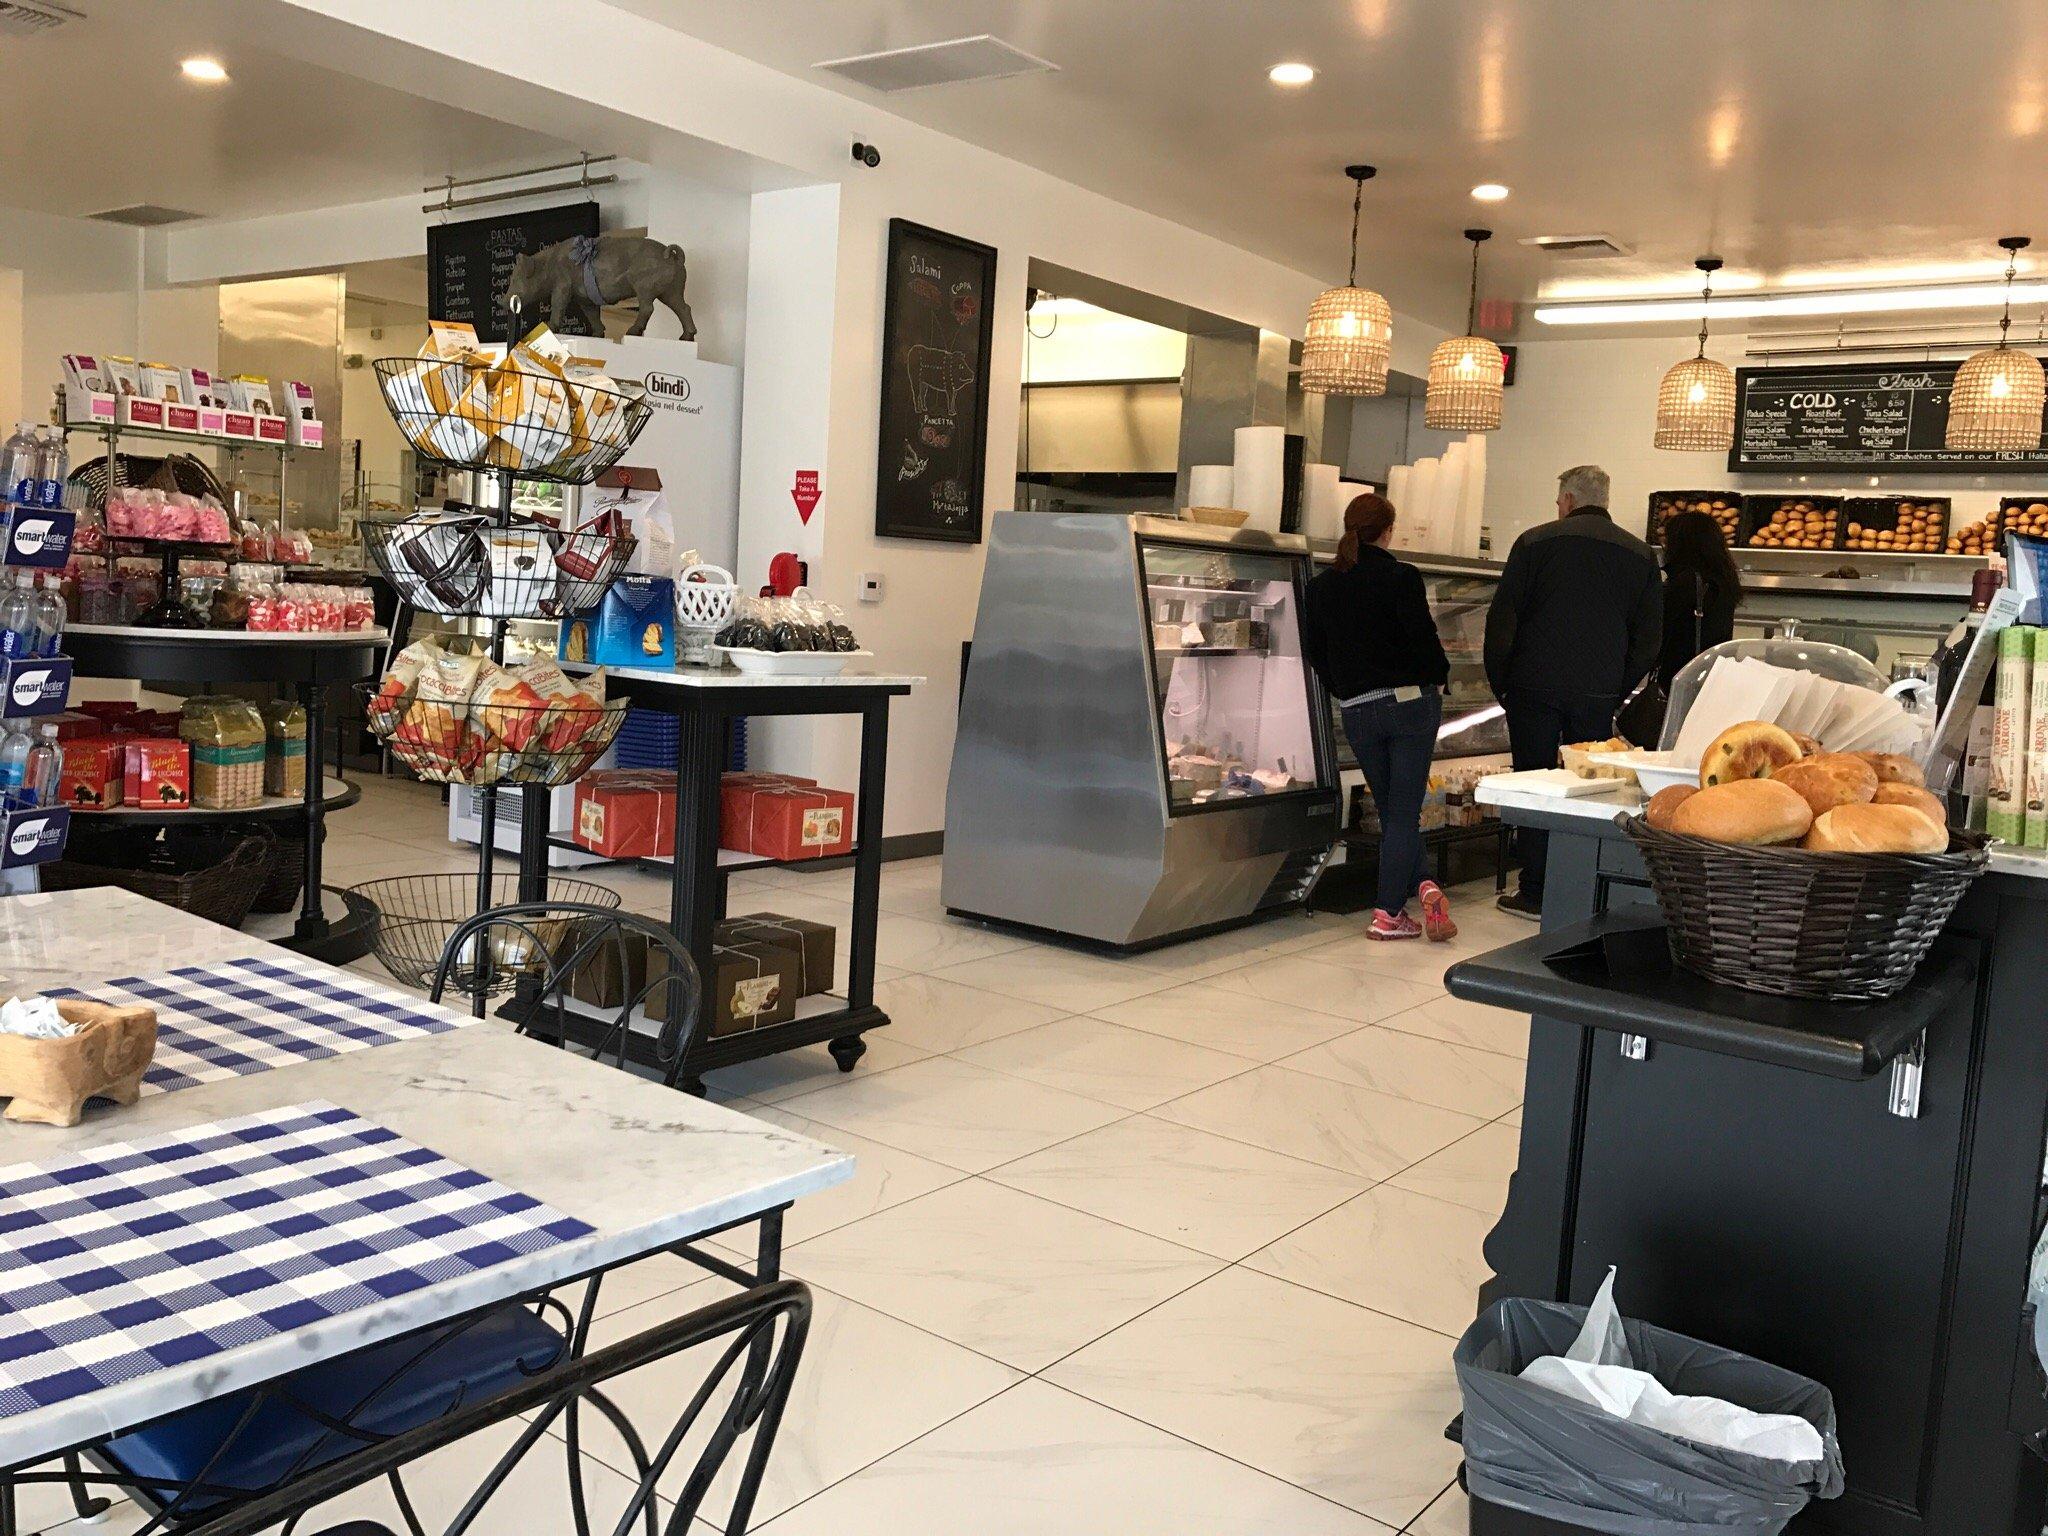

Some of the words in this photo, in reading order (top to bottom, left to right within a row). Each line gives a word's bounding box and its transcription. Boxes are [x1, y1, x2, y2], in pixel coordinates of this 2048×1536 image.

[909, 254, 941, 280] Salami
[651, 375, 684, 397] bindi
[133, 402, 160, 412] chuao
[1790, 393, 1836, 409] COLD
[170, 409, 195, 418] chuao
[227, 415, 251, 426] chuao
[261, 419, 283, 429] chuao
[1936, 452, 1962, 460] Served
[797, 476, 817, 484] PLEASE
[24, 478, 34, 501] water
[45, 480, 57, 503] water
[16, 531, 68, 545] smartwater
[626, 576, 653, 584] Motta
[3, 629, 15, 653] water
[14, 680, 65, 694] smartwater
[2000, 708, 2011, 758] TORRONE
[12, 827, 62, 844] smartwater
